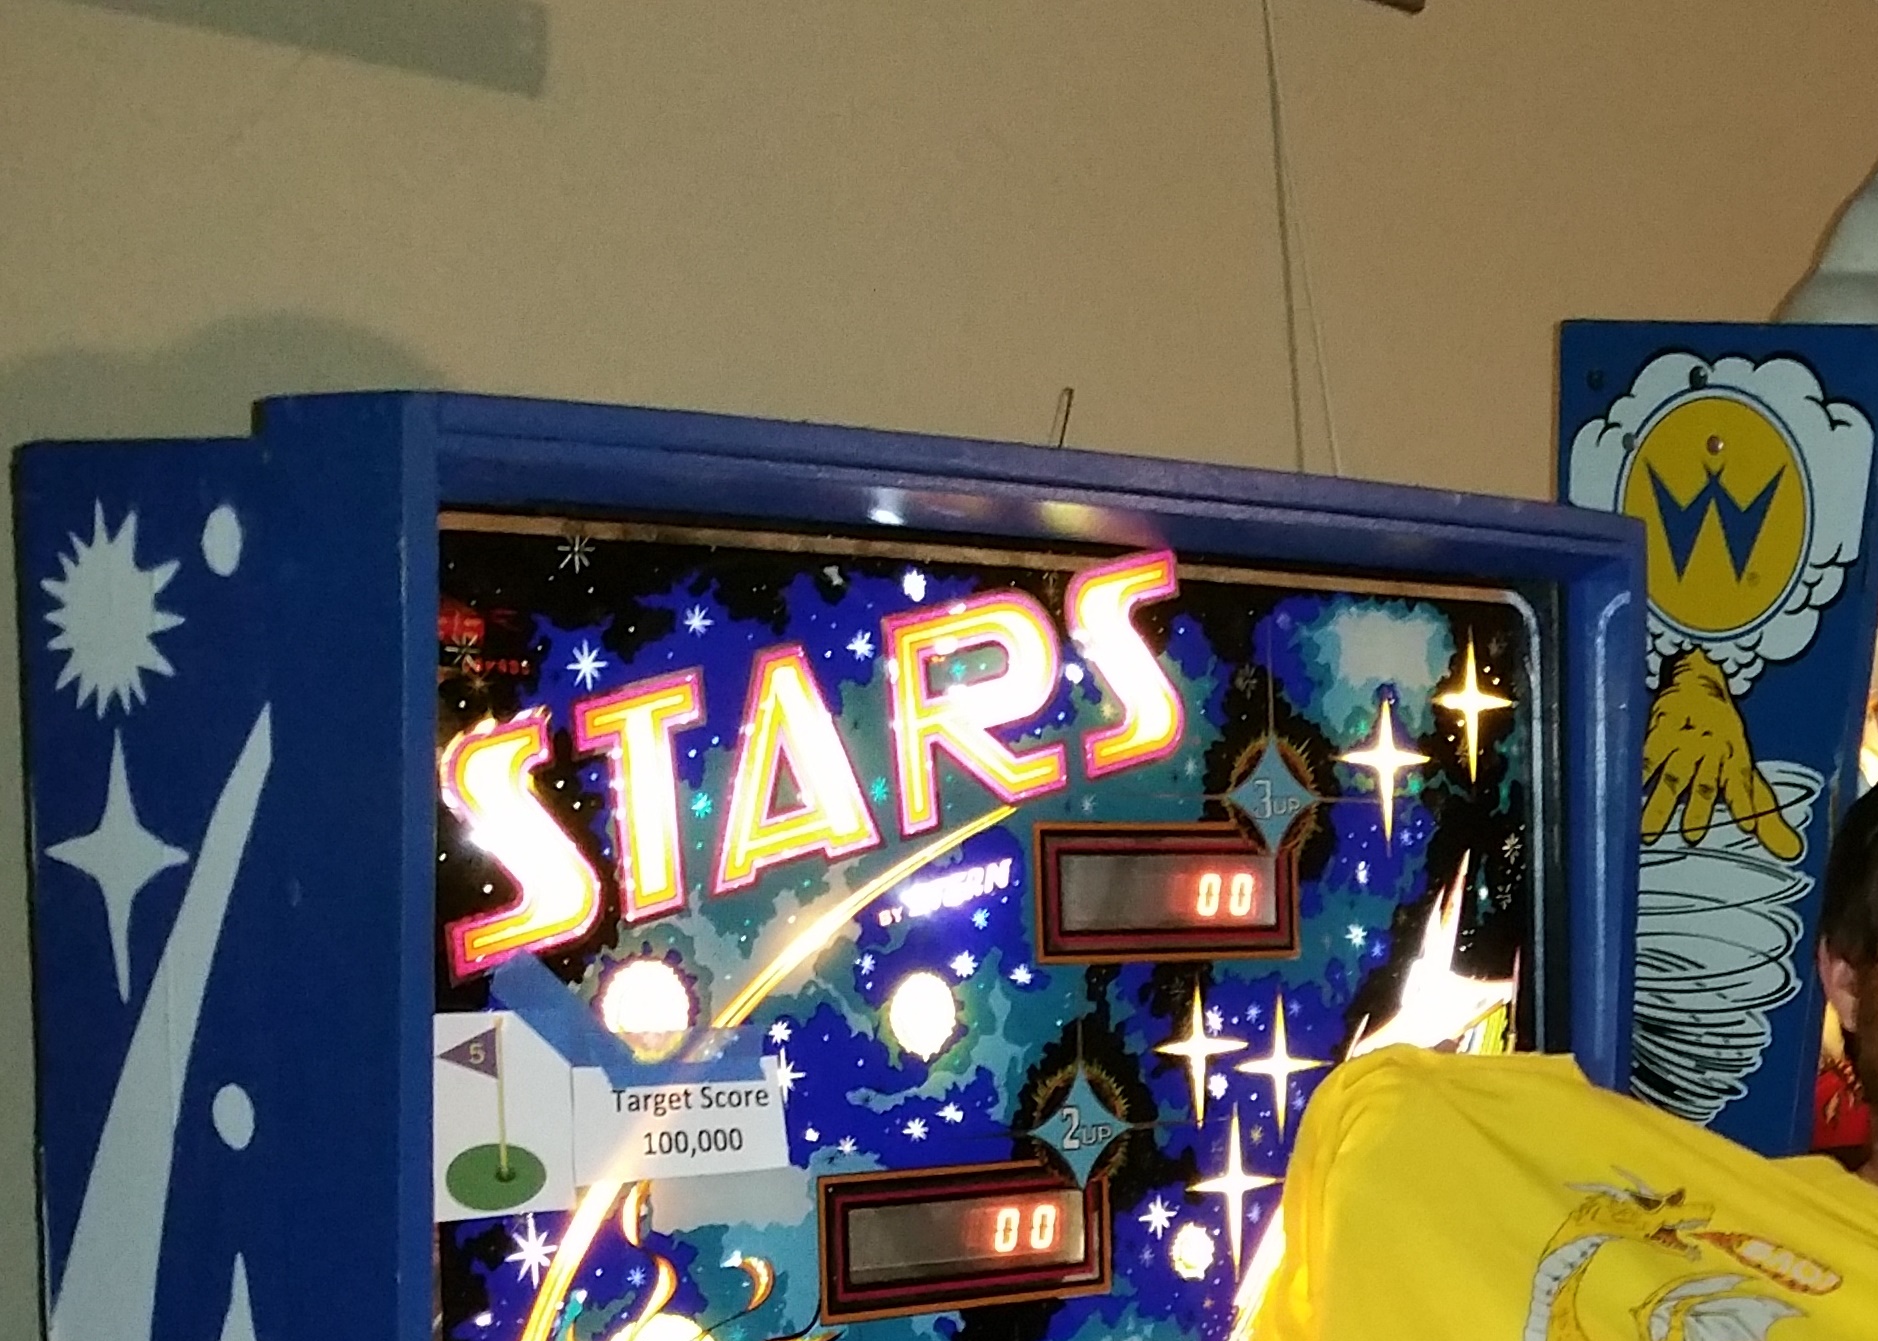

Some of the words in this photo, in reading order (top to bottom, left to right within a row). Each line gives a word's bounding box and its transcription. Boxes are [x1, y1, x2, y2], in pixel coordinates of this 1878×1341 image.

[440, 547, 1183, 988] STARS
[1196, 873, 1254, 917] 00
[878, 906, 903, 927] BY
[468, 1043, 486, 1065] 5
[611, 1087, 692, 1117] Target
[701, 1085, 769, 1109] Score
[644, 1127, 743, 1158] 100,000
[994, 1204, 1056, 1251] 00
